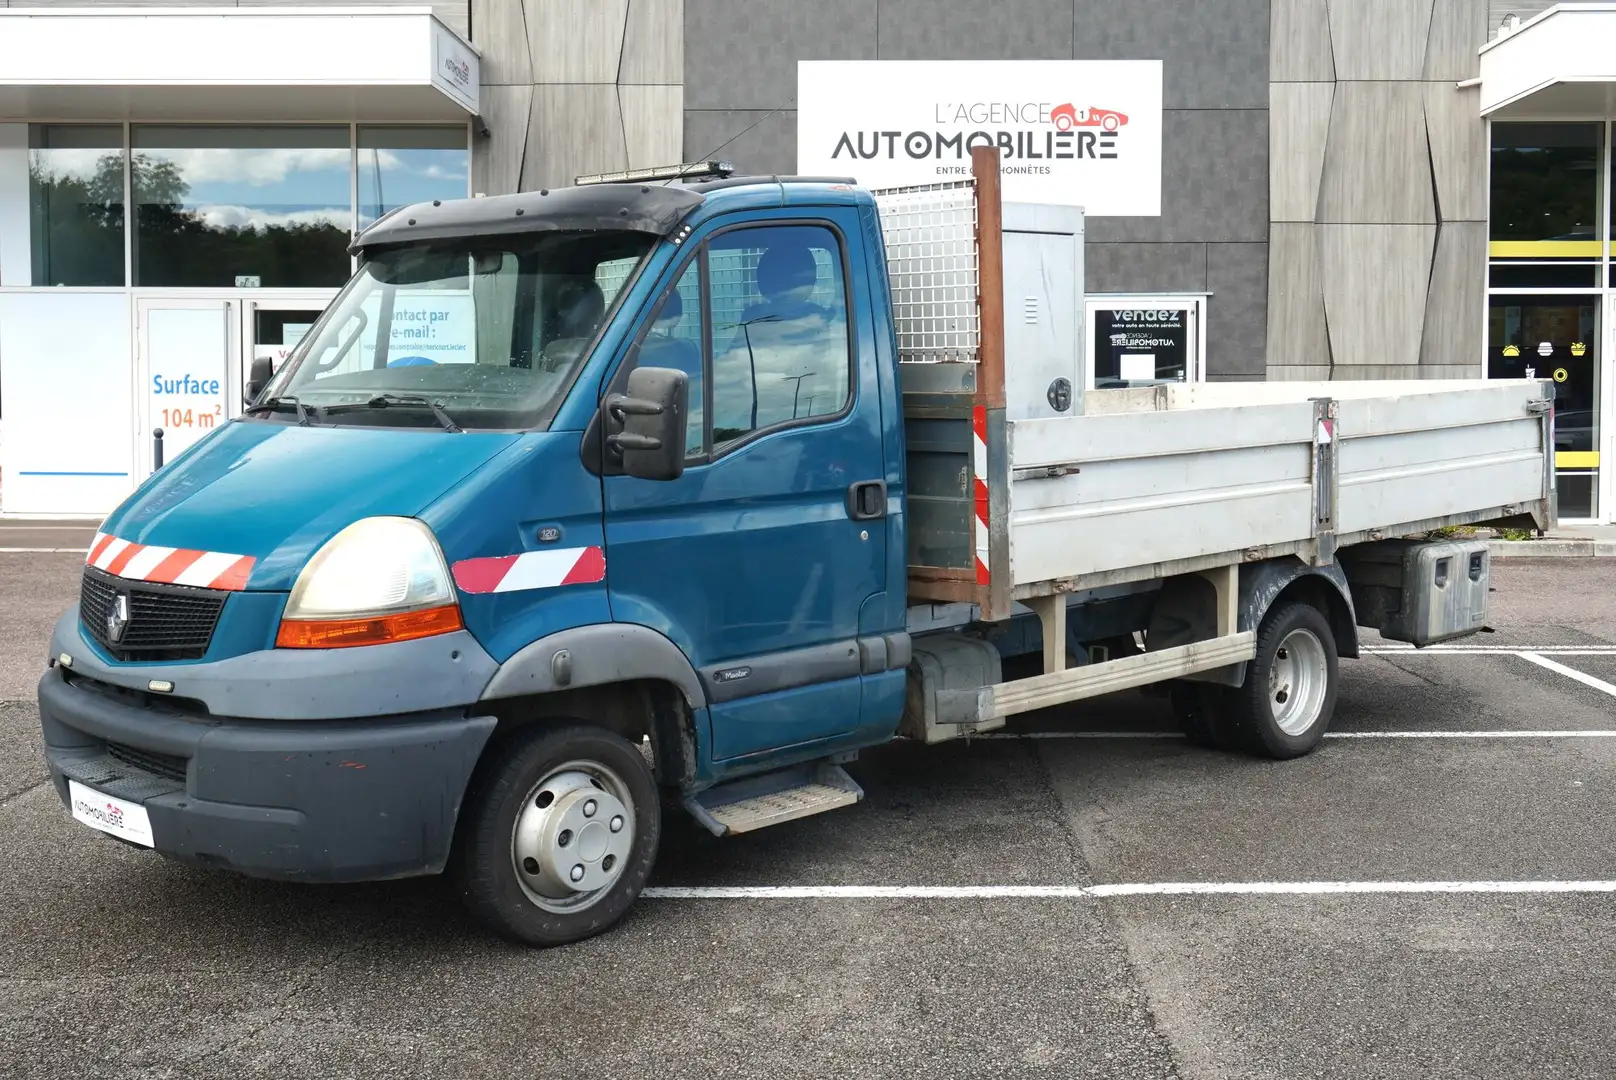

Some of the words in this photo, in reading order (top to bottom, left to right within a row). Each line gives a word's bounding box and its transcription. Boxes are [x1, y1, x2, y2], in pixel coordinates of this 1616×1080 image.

[391, 309, 426, 321] ontact
[430, 311, 450, 324] par
[392, 325, 429, 338] e-mail
[153, 374, 219, 394] Surface
[162, 409, 192, 427] 104
